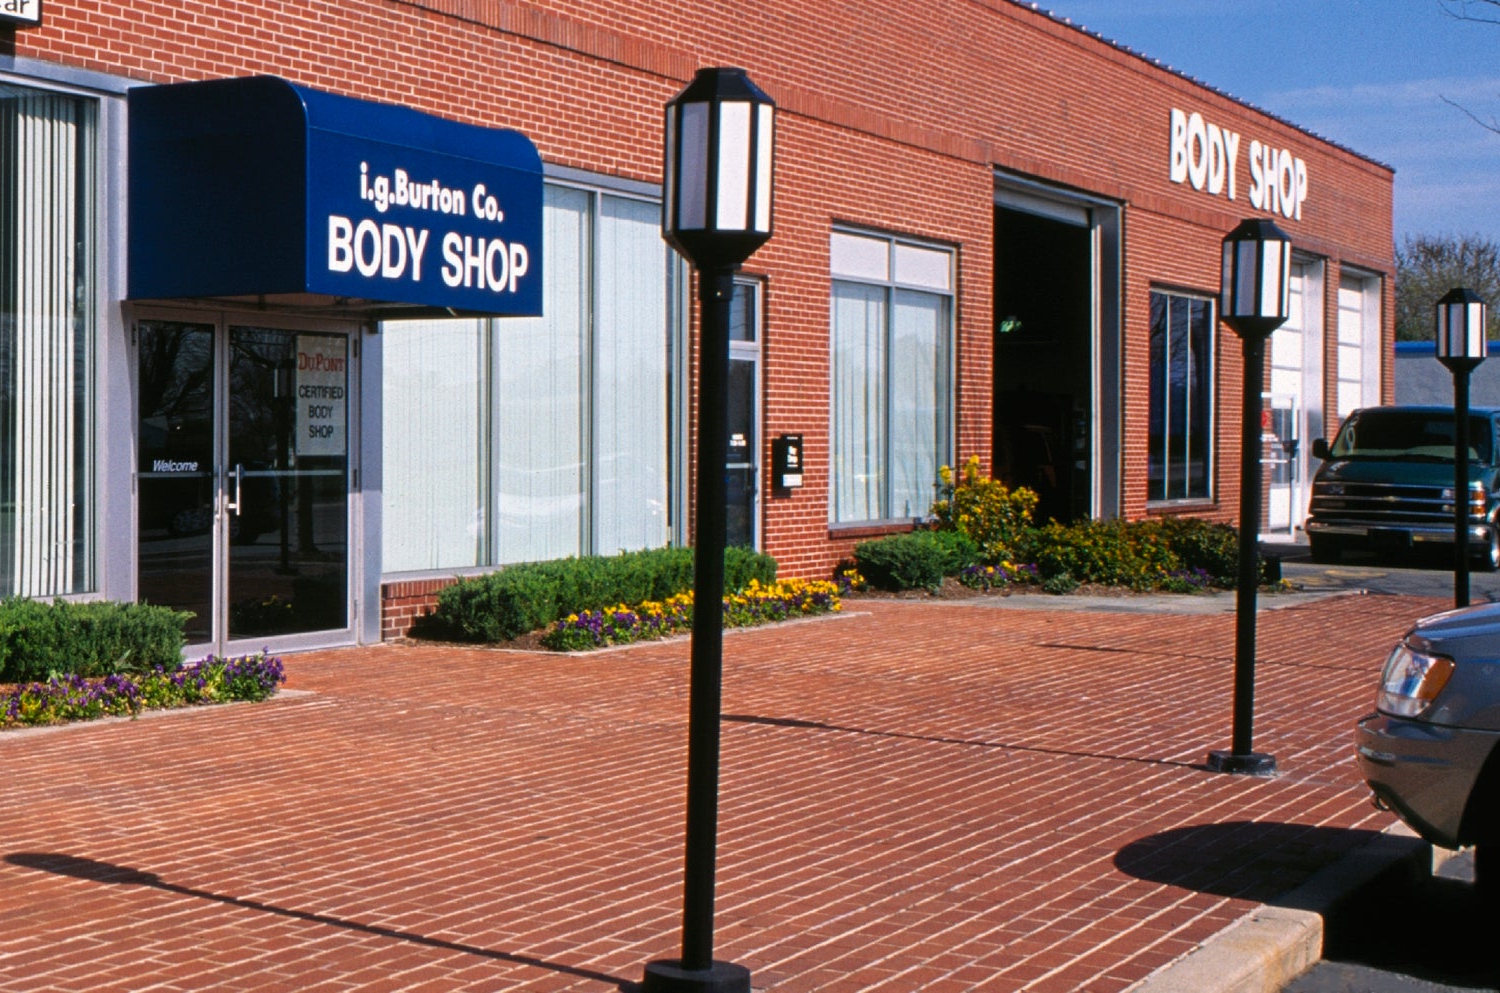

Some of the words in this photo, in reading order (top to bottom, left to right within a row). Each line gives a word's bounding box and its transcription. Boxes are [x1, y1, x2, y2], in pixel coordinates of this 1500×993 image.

[1169, 107, 1240, 201] BODY
[1249, 140, 1308, 221] SHOP
[472, 183, 504, 223] Co.
[328, 215, 429, 281] BODY
[441, 232, 529, 293] SHOP
[298, 385, 344, 399] CERTIFIED
[308, 405, 334, 419] BODY
[308, 424, 334, 439] SHOP
[153, 459, 199, 472] Welcome
